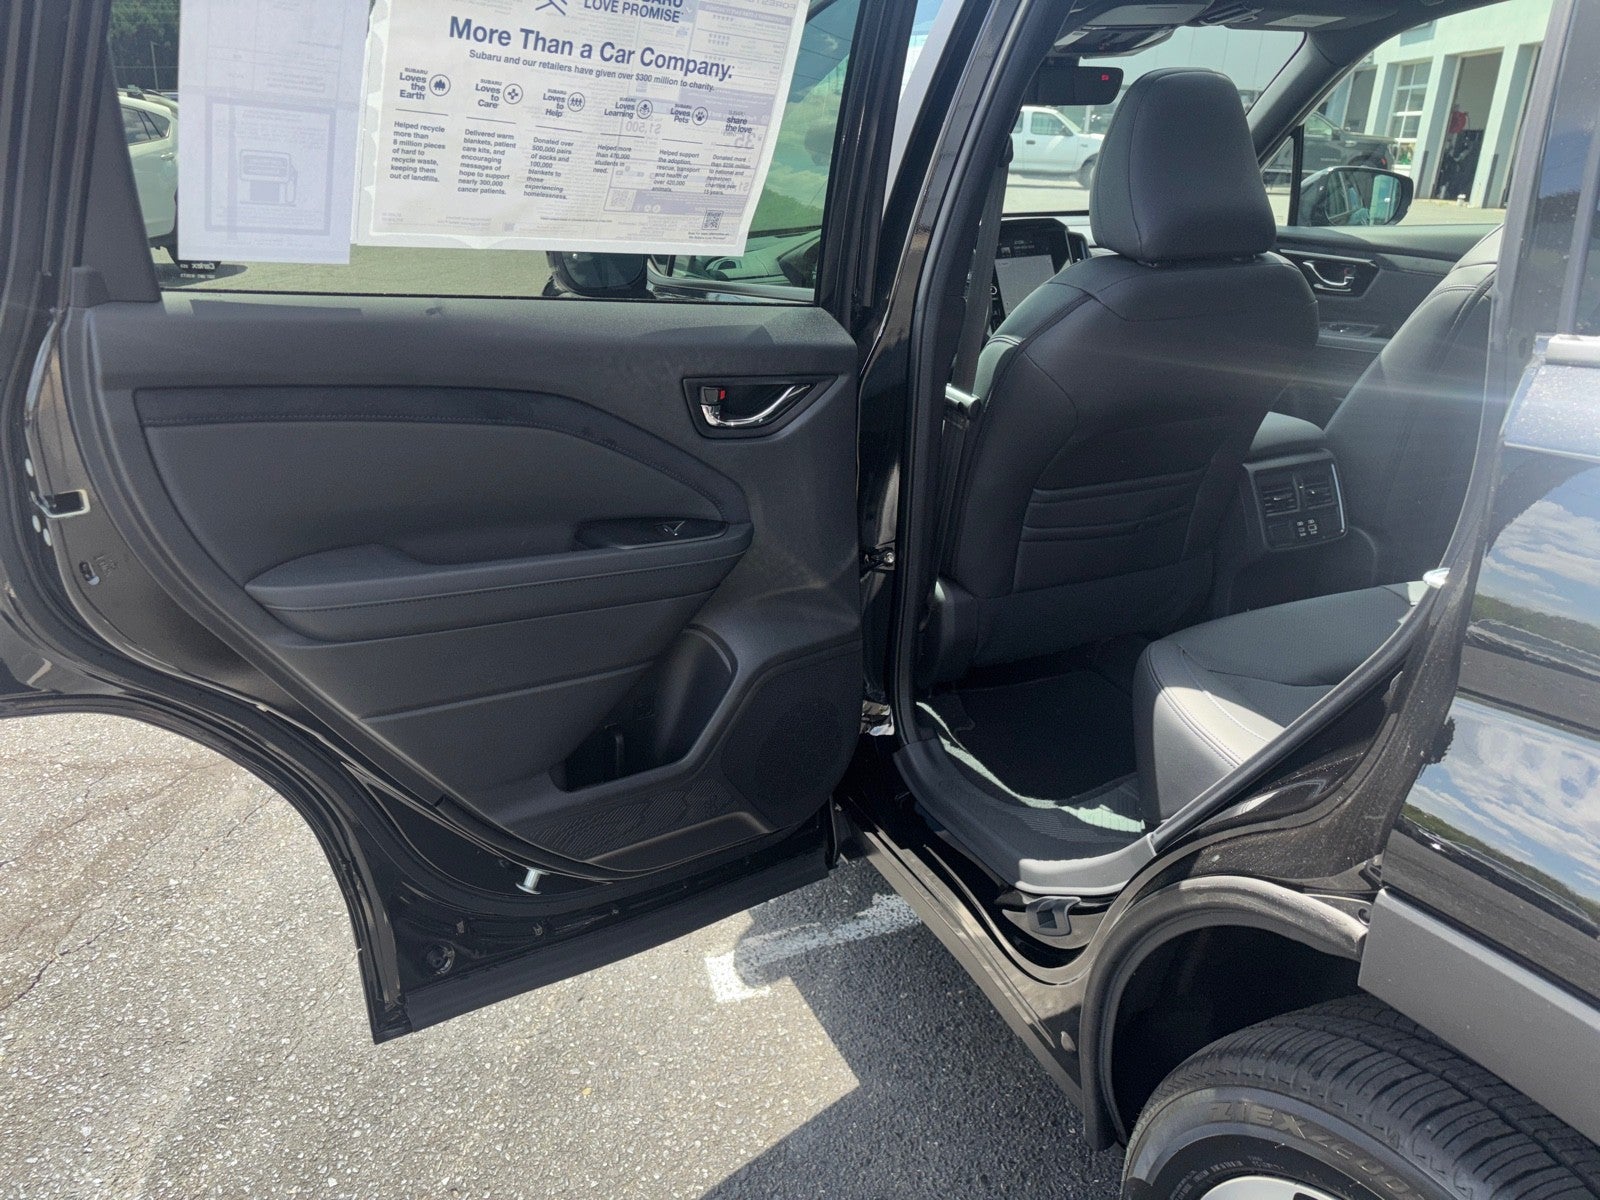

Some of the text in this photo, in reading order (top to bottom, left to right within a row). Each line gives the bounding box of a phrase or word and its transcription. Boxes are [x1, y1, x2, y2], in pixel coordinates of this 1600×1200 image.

[584, 0, 619, 13] LOVE
[622, 2, 680, 23] PROMISE
[450, 16, 511, 46] More
[520, 28, 573, 56] Than
[580, 43, 592, 60] a
[600, 42, 635, 64] Car
[640, 47, 733, 82] Company.
[469, 50, 501, 62] Subaru
[504, 56, 520, 65] and
[539, 60, 572, 72] retailers
[574, 65, 593, 75] have
[596, 69, 616, 78] given
[635, 73, 653, 82] $300
[654, 76, 678, 85] million
[689, 81, 715, 92] charity.
[400, 72, 426, 83] Loves
[411, 82, 425, 91] the
[475, 84, 501, 94] Loves
[400, 89, 425, 100] Earth
[543, 93, 566, 103] Loves
[478, 99, 498, 109] Care
[615, 102, 635, 111] Loves
[546, 108, 563, 118] Help
[604, 108, 634, 119] Learning
[670, 108, 691, 117] Loves
[674, 115, 689, 124] Pets
[727, 116, 747, 125] share
[394, 121, 445, 133] Helped recycle
[738, 125, 752, 133] love
[465, 129, 495, 137] Delivered
[533, 137, 559, 145] Donated
[461, 154, 502, 164] encouraging
[391, 164, 417, 173] keeping
[460, 162, 492, 171] messages
[525, 184, 563, 193] experiencing
